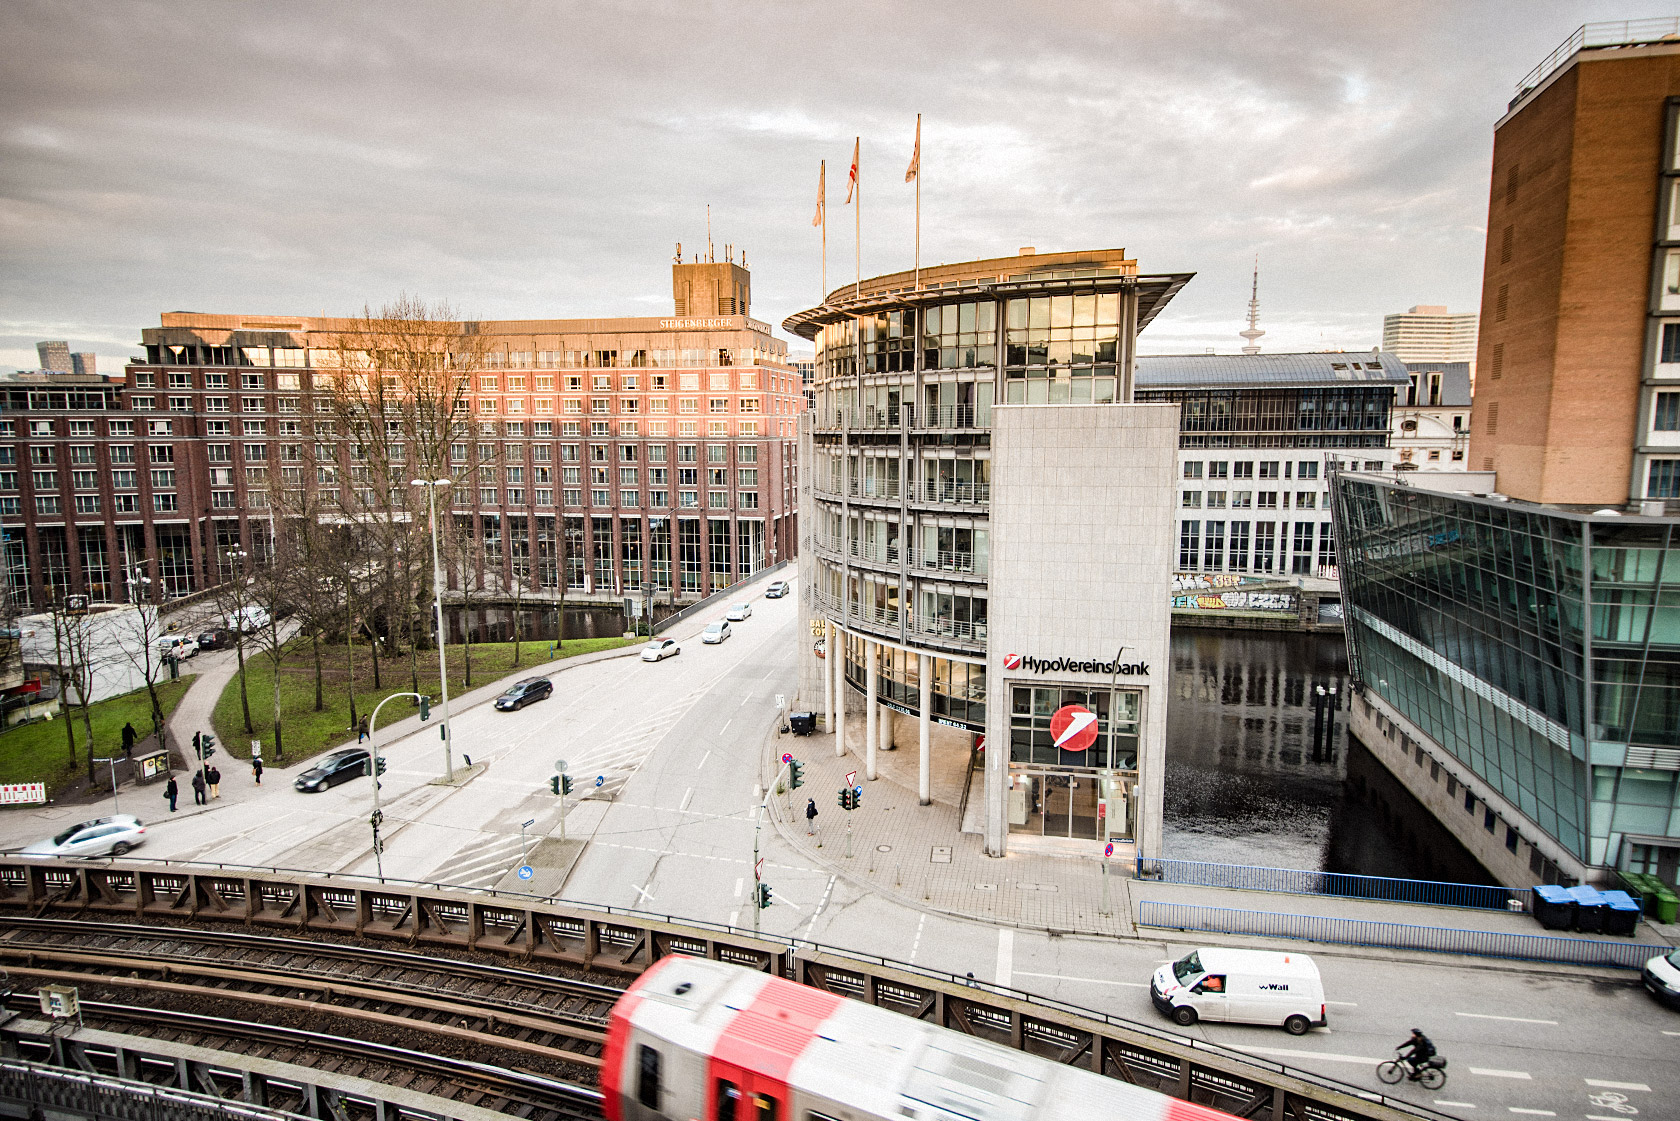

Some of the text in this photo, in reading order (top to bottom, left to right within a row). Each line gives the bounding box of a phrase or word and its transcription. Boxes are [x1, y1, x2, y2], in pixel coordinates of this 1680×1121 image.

[660, 318, 732, 329] STEIGENBERGER
[1022, 655, 1150, 676] HypoVereinsbank
[1268, 983, 1289, 991] Wall
